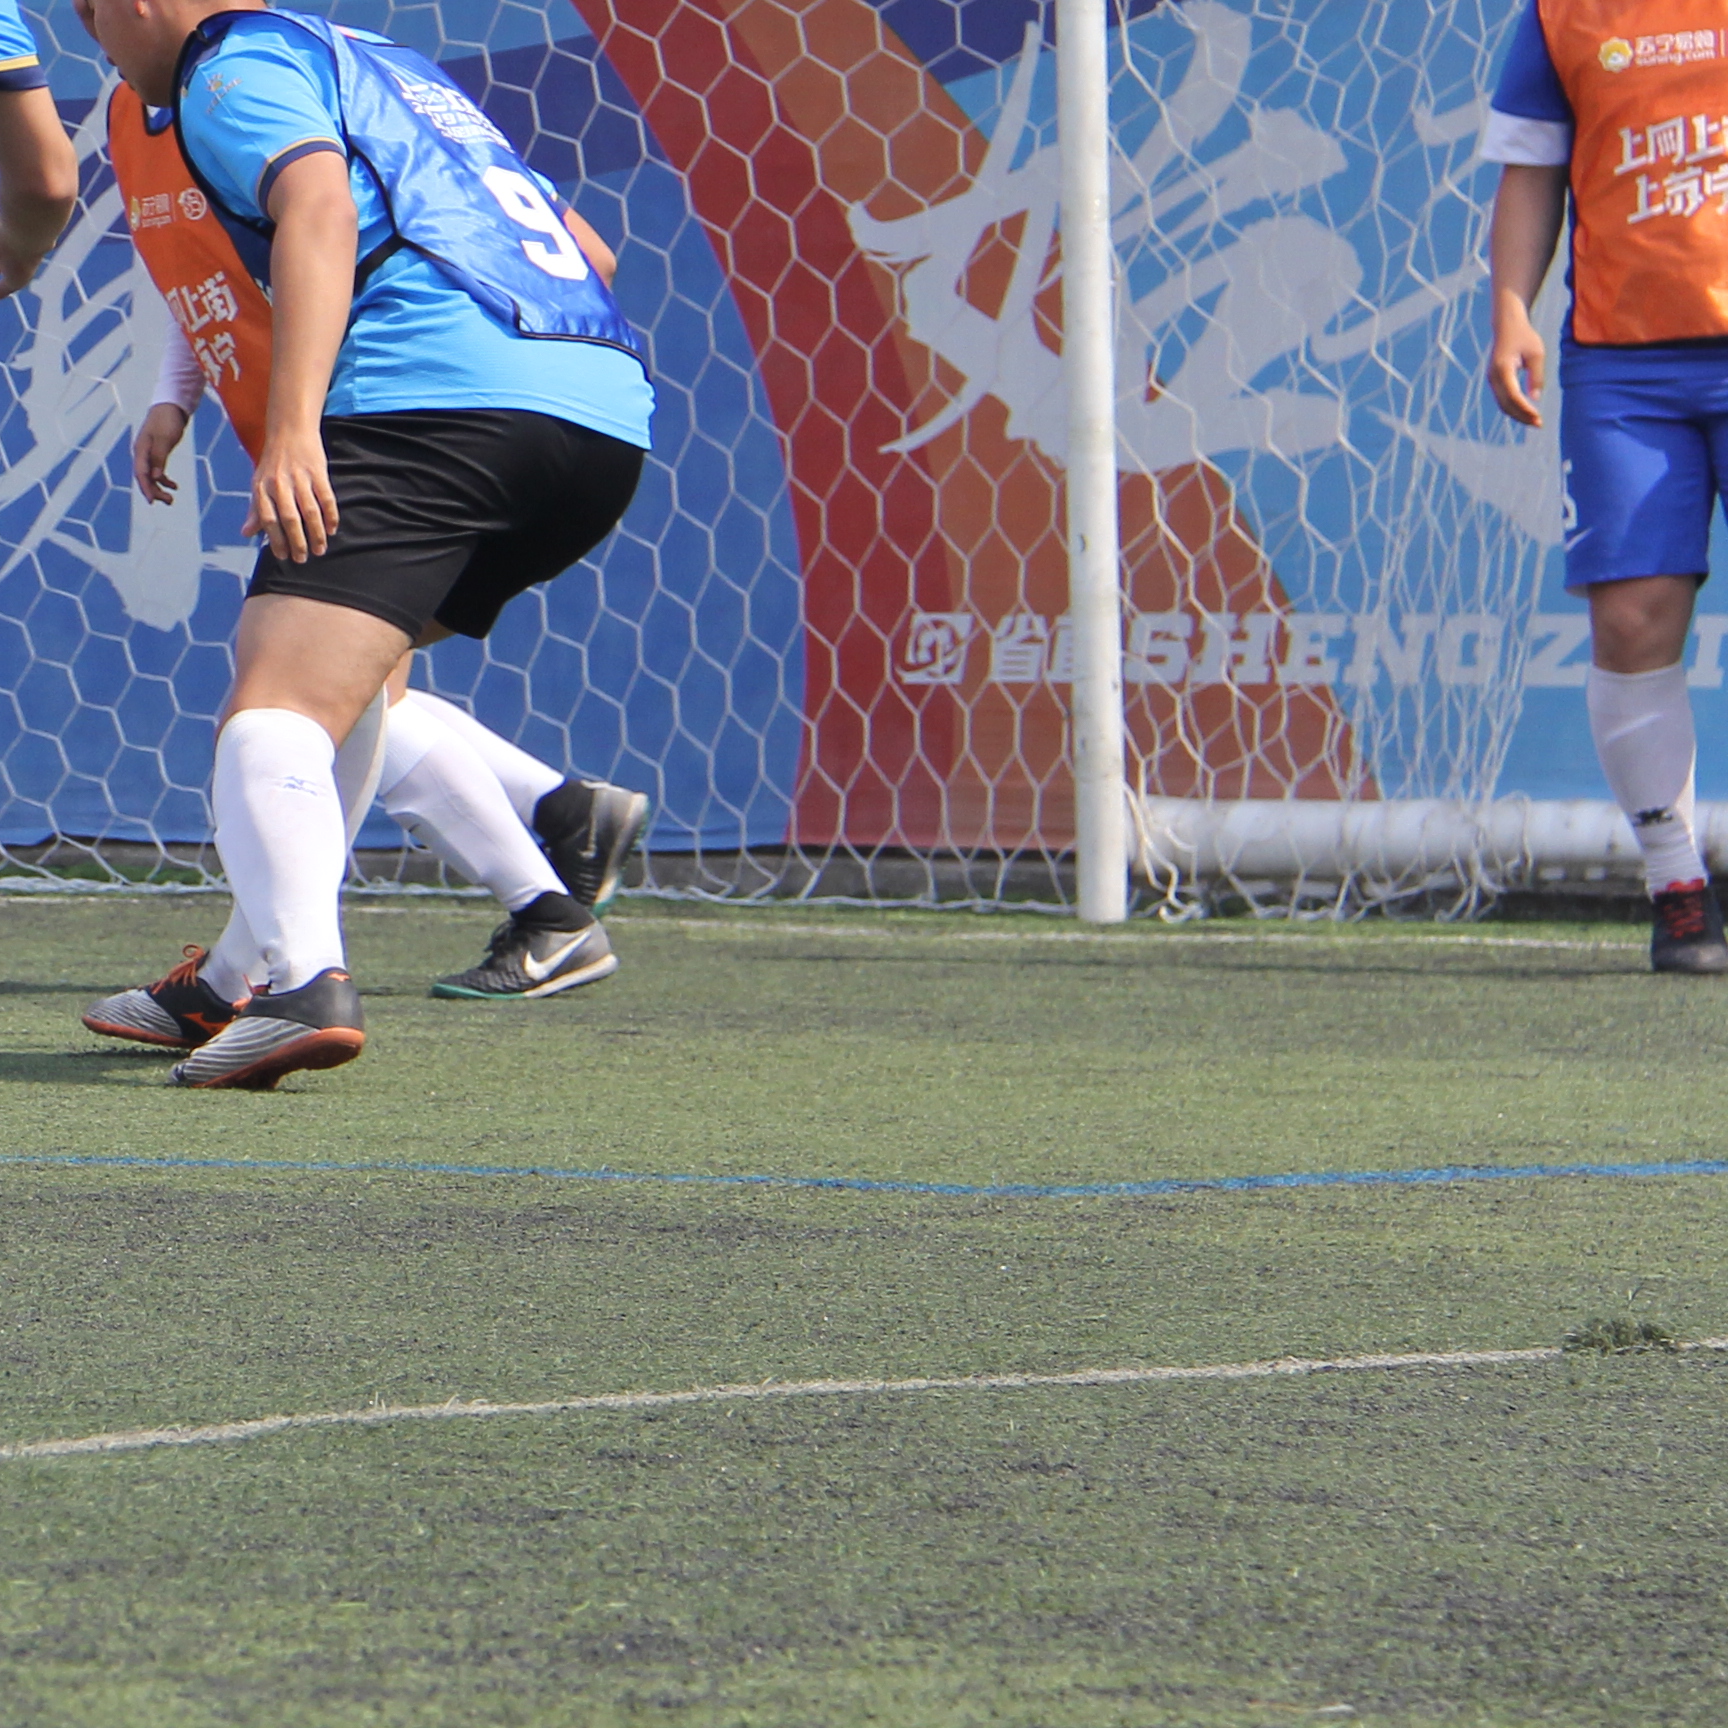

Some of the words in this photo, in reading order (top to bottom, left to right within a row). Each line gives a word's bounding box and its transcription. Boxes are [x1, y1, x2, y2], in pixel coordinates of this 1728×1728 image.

[1613, 113, 1728, 176] 上网上
[482, 165, 591, 282] 9
[1122, 612, 1507, 686] SHENG
[1522, 613, 1728, 687] ZI
